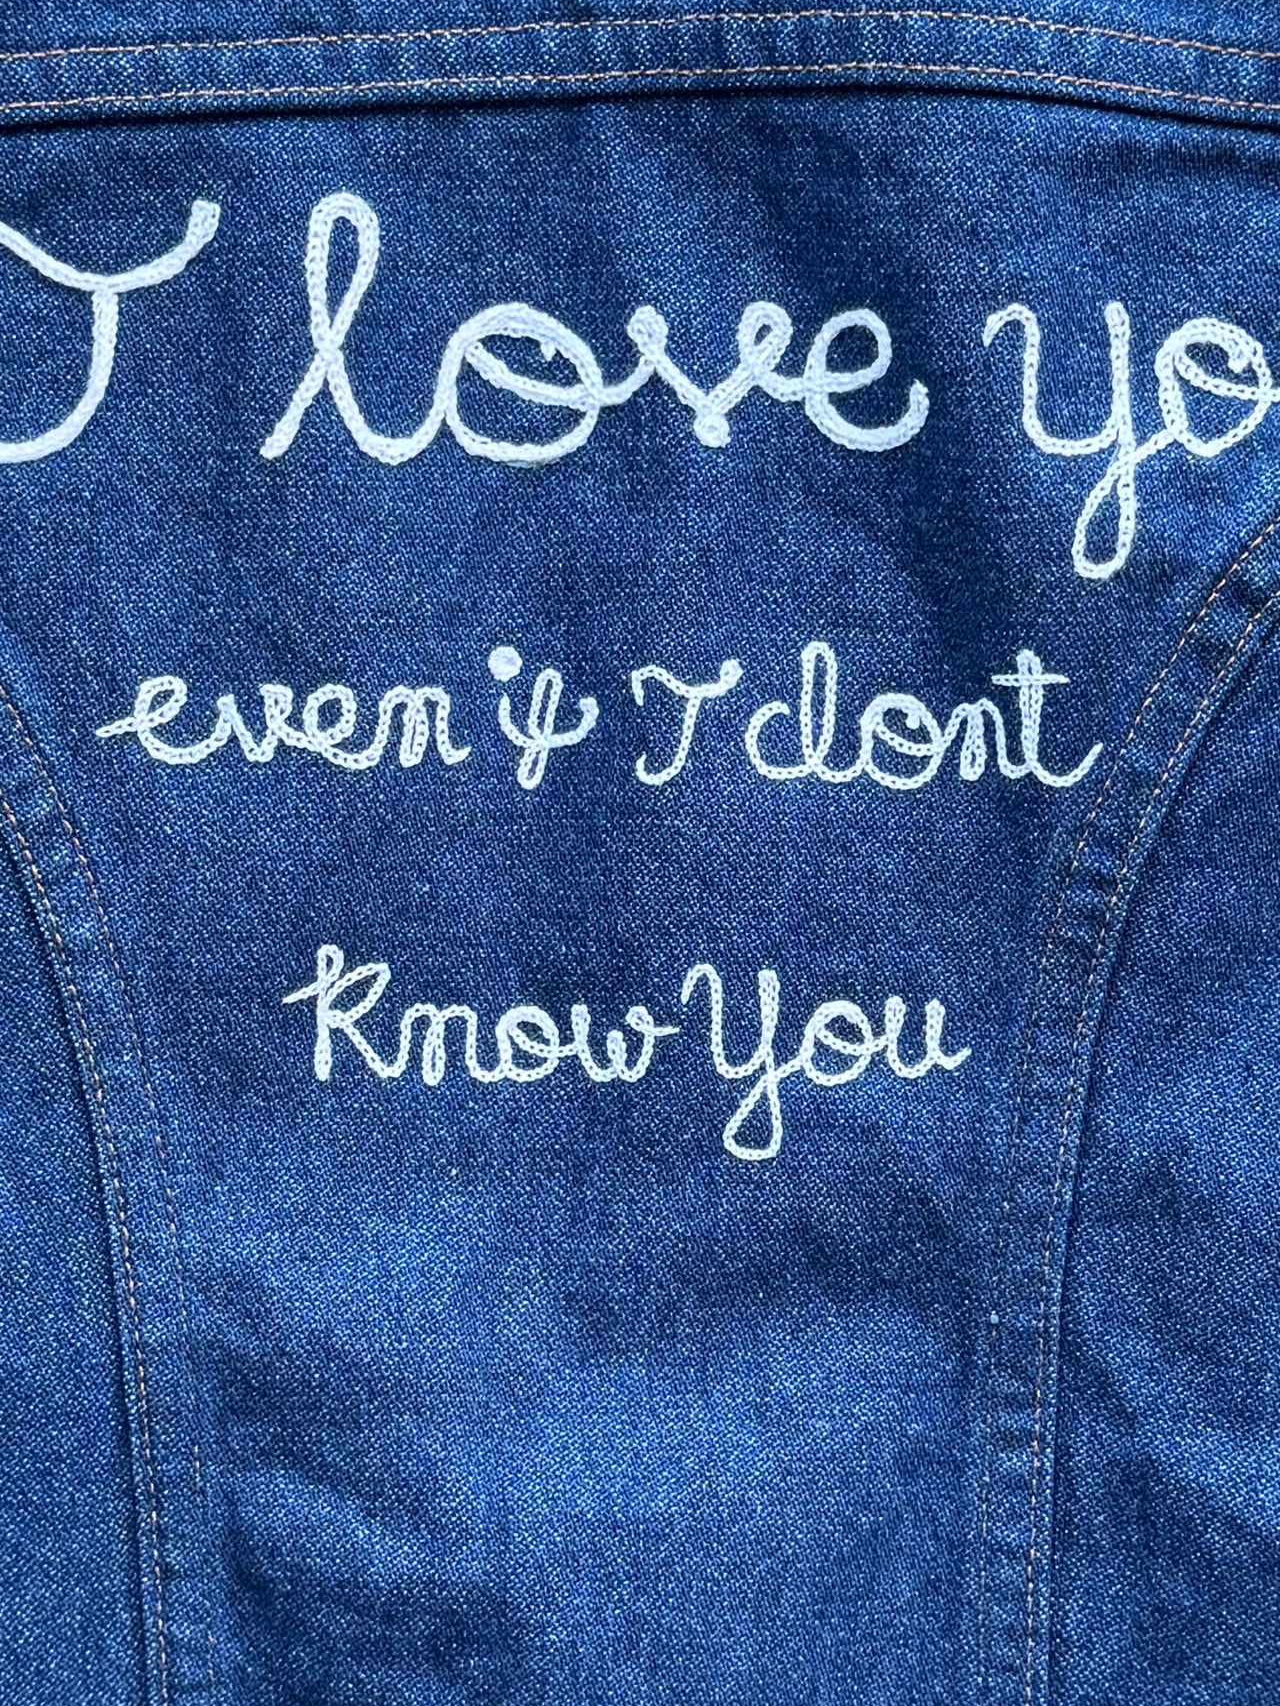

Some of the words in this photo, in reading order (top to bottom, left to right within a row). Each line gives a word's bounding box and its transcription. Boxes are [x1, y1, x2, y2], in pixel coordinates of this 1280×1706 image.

[261, 192, 929, 466] love
[95, 675, 472, 768] even
[488, 646, 599, 789] if
[631, 659, 742, 786] I
[746, 641, 1104, 790] dont
